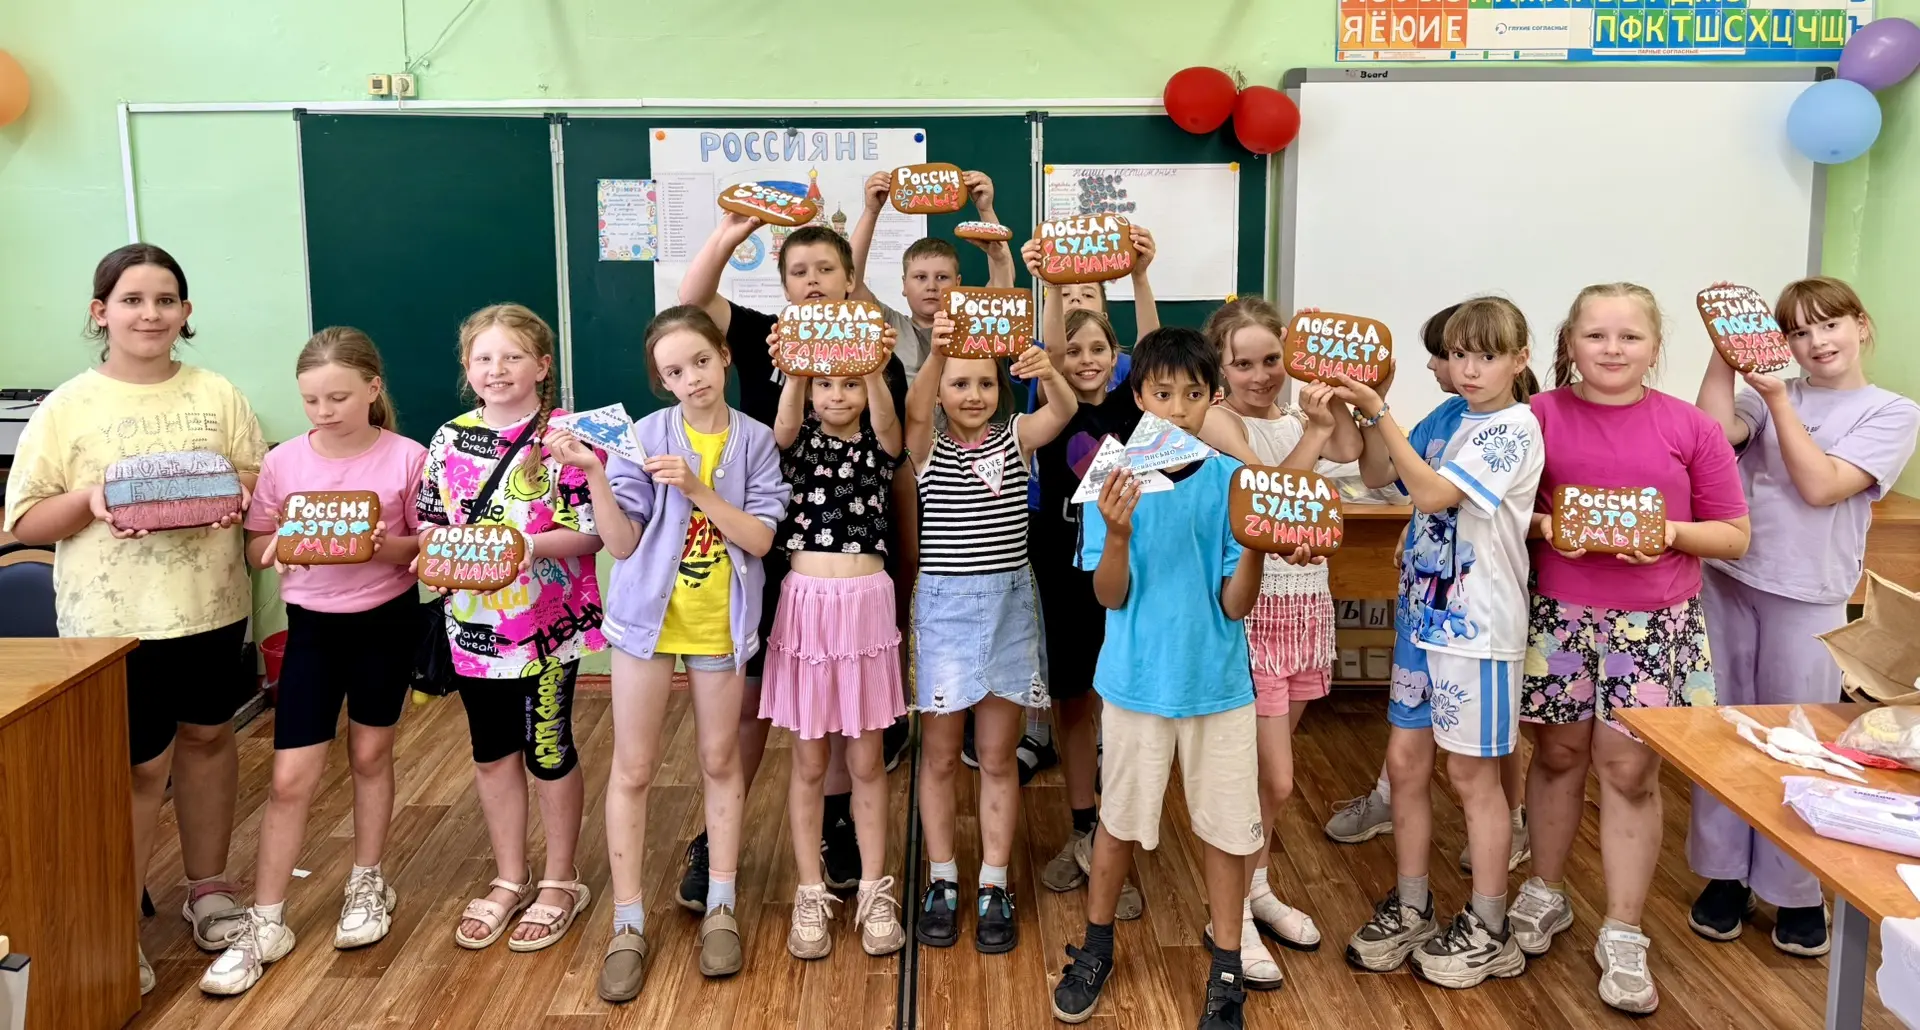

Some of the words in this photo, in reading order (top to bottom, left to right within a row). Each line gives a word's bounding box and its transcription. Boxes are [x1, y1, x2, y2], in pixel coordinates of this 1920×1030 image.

[700, 131, 879, 162] РОССИЯНЕ
[1041, 215, 1119, 238] ПОБЕДА
[1055, 233, 1121, 255] БУДЕТ
[1074, 251, 1131, 274] НАМИ
[784, 303, 868, 321] ПОБЕДА
[799, 322, 870, 340] БУДЕТ
[1296, 317, 1380, 343] ПОБЕДА
[813, 342, 876, 362] НАМИ
[1307, 335, 1376, 362] БУДЕТ
[461, 430, 488, 443] have
[1473, 424, 1507, 446] GOOD
[978, 459, 1002, 472] GIVE
[1144, 449, 1175, 461] ПИСЬМО
[985, 469, 1001, 478] WAY
[1240, 468, 1331, 500] ПОБЕДА
[1252, 493, 1324, 523] БУДЕТ
[432, 527, 514, 545] ПОБЕДА
[441, 542, 506, 562] БУДЕТ
[453, 561, 512, 580] НАМИ
[1435, 677, 1472, 704] LUCK!
